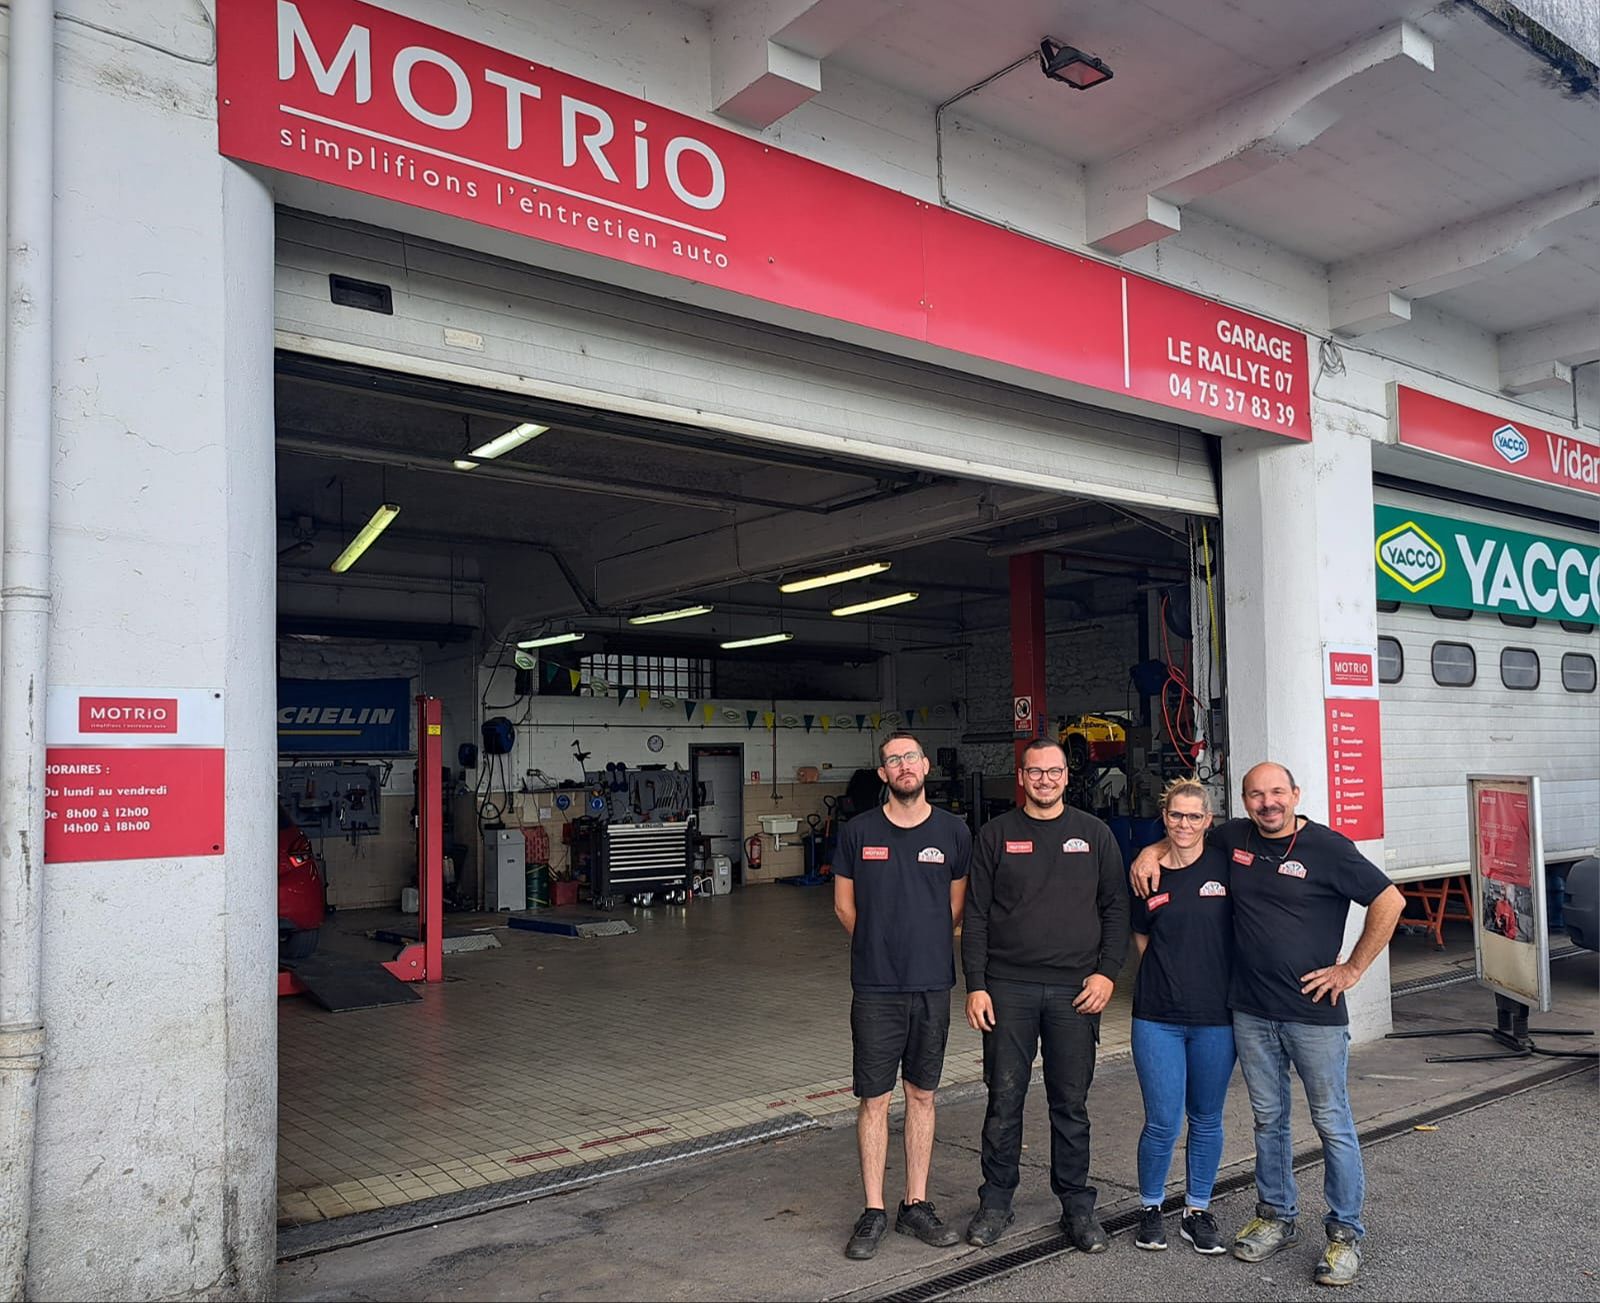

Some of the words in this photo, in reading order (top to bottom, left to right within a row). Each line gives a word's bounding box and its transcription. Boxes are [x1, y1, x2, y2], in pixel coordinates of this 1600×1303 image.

[280, 127, 478, 198] simplifions
[497, 184, 657, 249] l'entretien
[672, 240, 729, 269] auto
[1217, 319, 1292, 364] GARAGE
[1167, 337, 1192, 366] LE
[1198, 345, 1271, 389] RALLYE
[1275, 371, 1293, 394] 07
[1168, 373, 1192, 401] 04
[1198, 381, 1219, 406] 75
[1225, 388, 1245, 413] 37
[1251, 395, 1271, 421] 83
[1276, 403, 1295, 428] 39
[1496, 435, 1526, 452] YACCO
[1386, 545, 1436, 569] YACCO
[63, 786, 94, 797] lundi
[98, 788, 112, 796] au
[117, 785, 167, 796] vendredi
[66, 808, 97, 819] 8h00
[102, 807, 109, 818] à
[115, 807, 149, 818] 12h00
[63, 822, 99, 833] 14h00
[103, 822, 111, 832] à
[116, 821, 150, 832] 18h00
